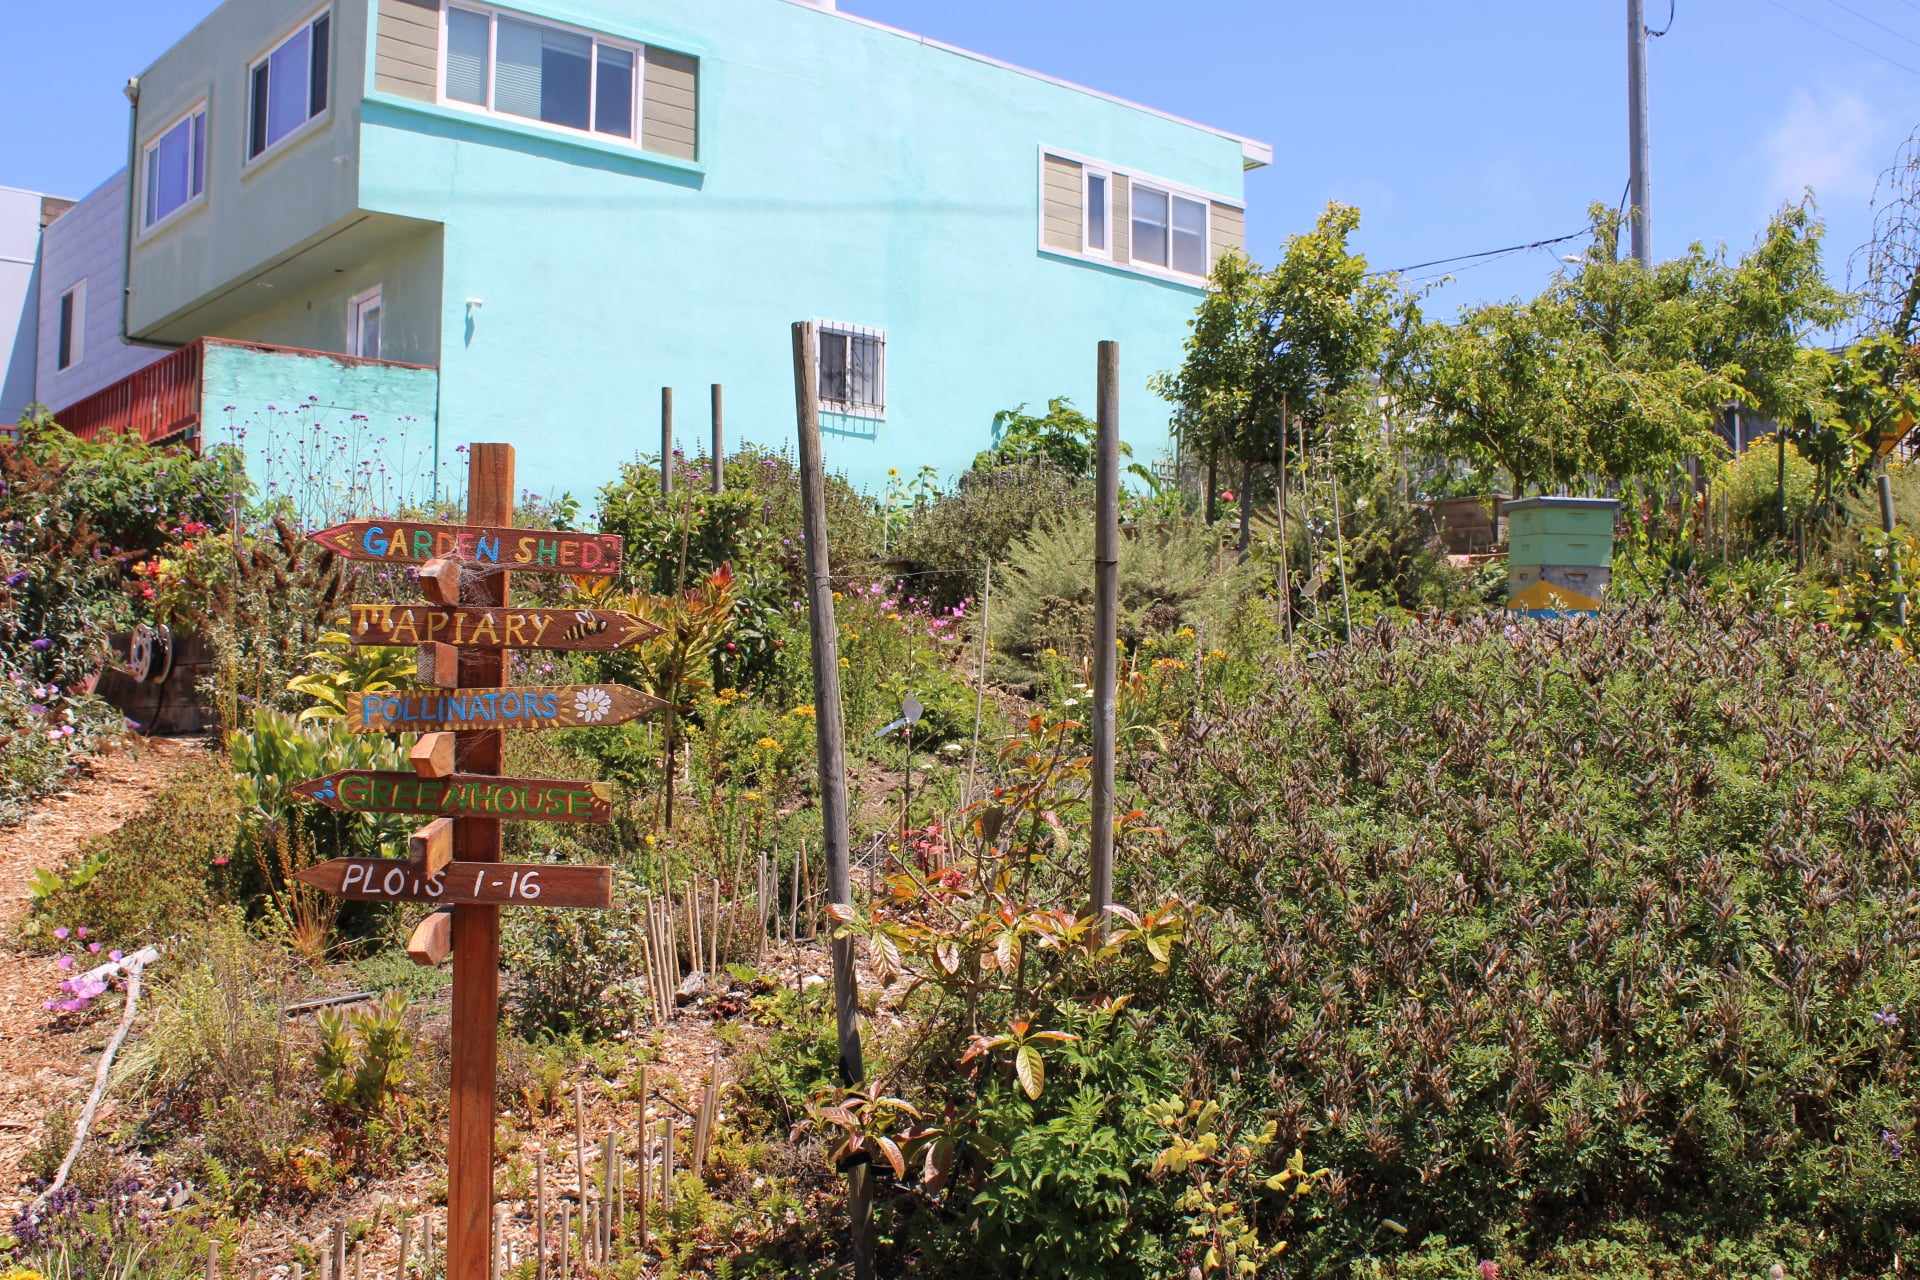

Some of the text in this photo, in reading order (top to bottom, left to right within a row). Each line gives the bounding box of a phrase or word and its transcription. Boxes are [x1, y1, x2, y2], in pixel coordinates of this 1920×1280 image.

[363, 527, 602, 567] GARDEN SHED
[391, 609, 554, 647] APIARY
[361, 692, 559, 725] POLLINATORS
[337, 775, 593, 817] GREENHOUSE
[473, 870, 541, 899] 1-16
